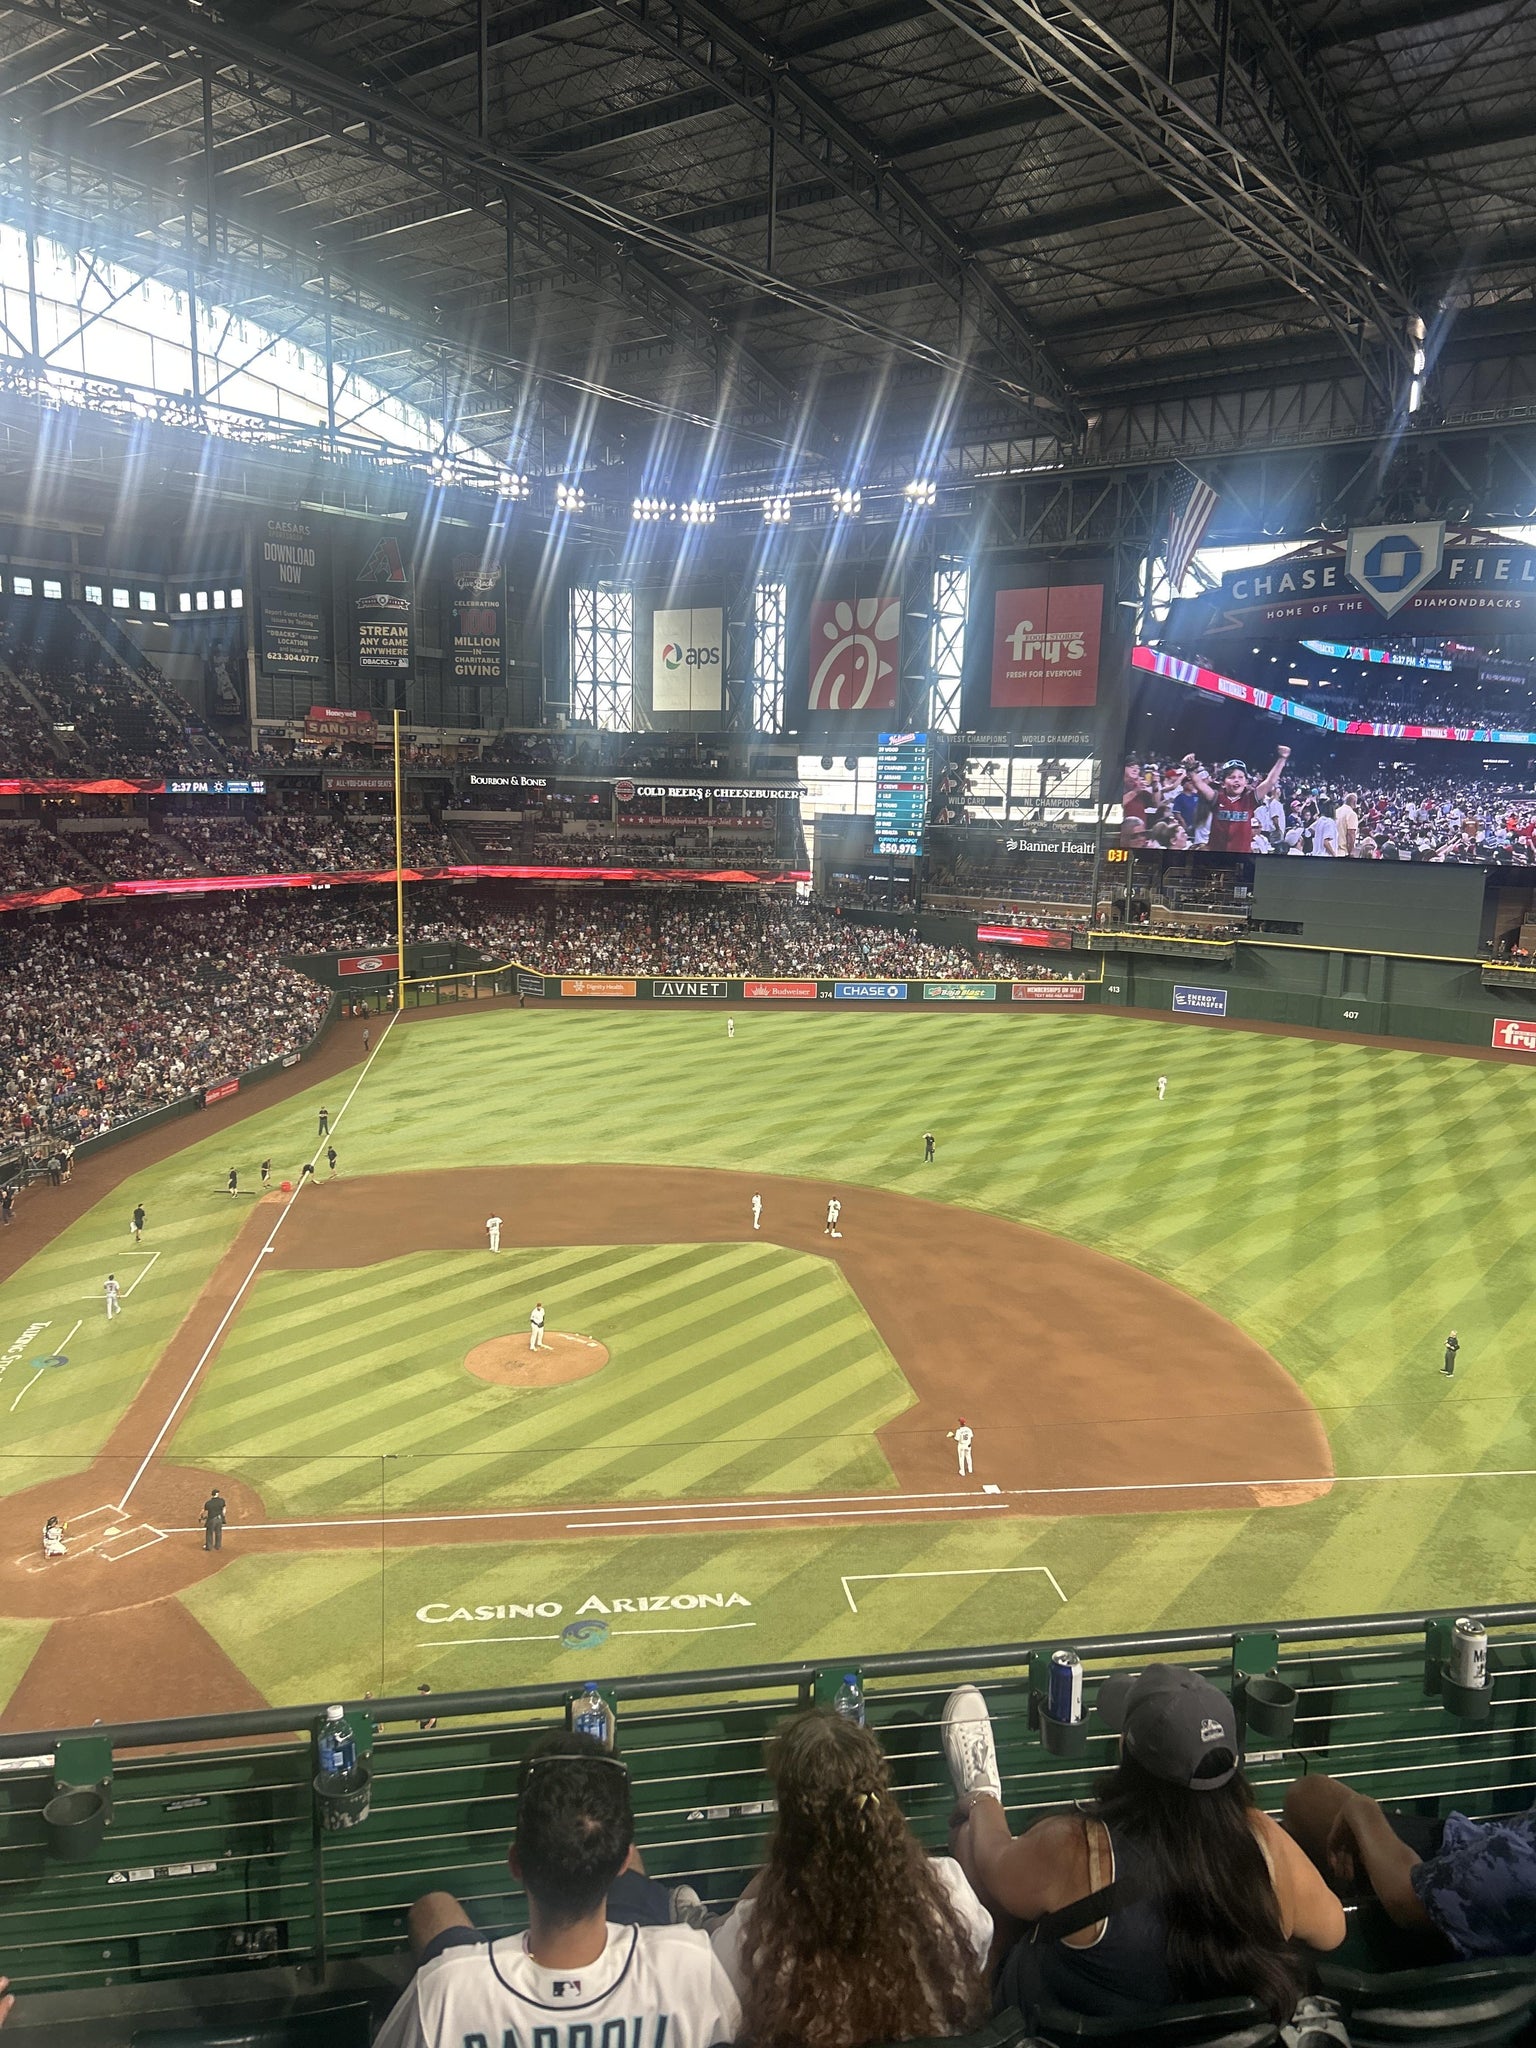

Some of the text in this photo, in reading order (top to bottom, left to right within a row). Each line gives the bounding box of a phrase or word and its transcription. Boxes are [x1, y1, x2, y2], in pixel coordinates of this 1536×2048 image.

[267, 520, 311, 535] CAESARS
[264, 542, 316, 567] DOWNLOAD
[280, 564, 301, 584] NOW
[1231, 566, 1337, 600] CHASE
[454, 600, 500, 608] CELEBRATING
[1267, 597, 1522, 619] HOME OF THE DIAMONDBACKS
[359, 625, 408, 637] STREAM
[454, 636, 501, 647] MILLION
[1050, 632, 1081, 641] STORES
[278, 638, 309, 647] LOCATION
[360, 638, 409, 647] ANY GAME
[1005, 620, 1087, 664] fry's
[360, 647, 409, 656] ANYWHERE
[267, 652, 320, 663] 623.304.0777
[454, 656, 500, 664] CHARITABLE
[685, 647, 720, 669] aps
[454, 665, 501, 676] GIVING
[1006, 669, 1083, 679] FRESH FOR EVERYONE
[325, 709, 357, 718] Honeywell
[936, 735, 1007, 743] NL WEST CHAMPIONS
[1022, 735, 1090, 743] WORLD CHAMPIONS
[377, 780, 392, 788] SEATS
[470, 774, 547, 787] BOURBON & BONES
[171, 782, 209, 792] 2:37 PM
[637, 786, 666, 797] COLD
[669, 787, 704, 798] BEERS
[704, 788, 712, 798] &
[714, 788, 806, 799] CHEESEBURGERS
[948, 797, 986, 805] WILD CARD
[1035, 798, 1080, 807] CHAMPIONS
[880, 842, 917, 854] $50,976
[1019, 840, 1059, 853] Banner
[586, 983, 606, 991] Dignity
[661, 983, 720, 996] AVNET
[772, 987, 811, 995] Budweiser
[843, 986, 886, 996] CHASE
[1108, 985, 1120, 993] 413
[820, 991, 833, 999] 374
[1187, 994, 1217, 1002] ENERGY
[1187, 1000, 1223, 1009] TRANSFER
[1343, 1010, 1359, 1020] 407
[415, 1591, 752, 1624] CASINO ARIZONA
